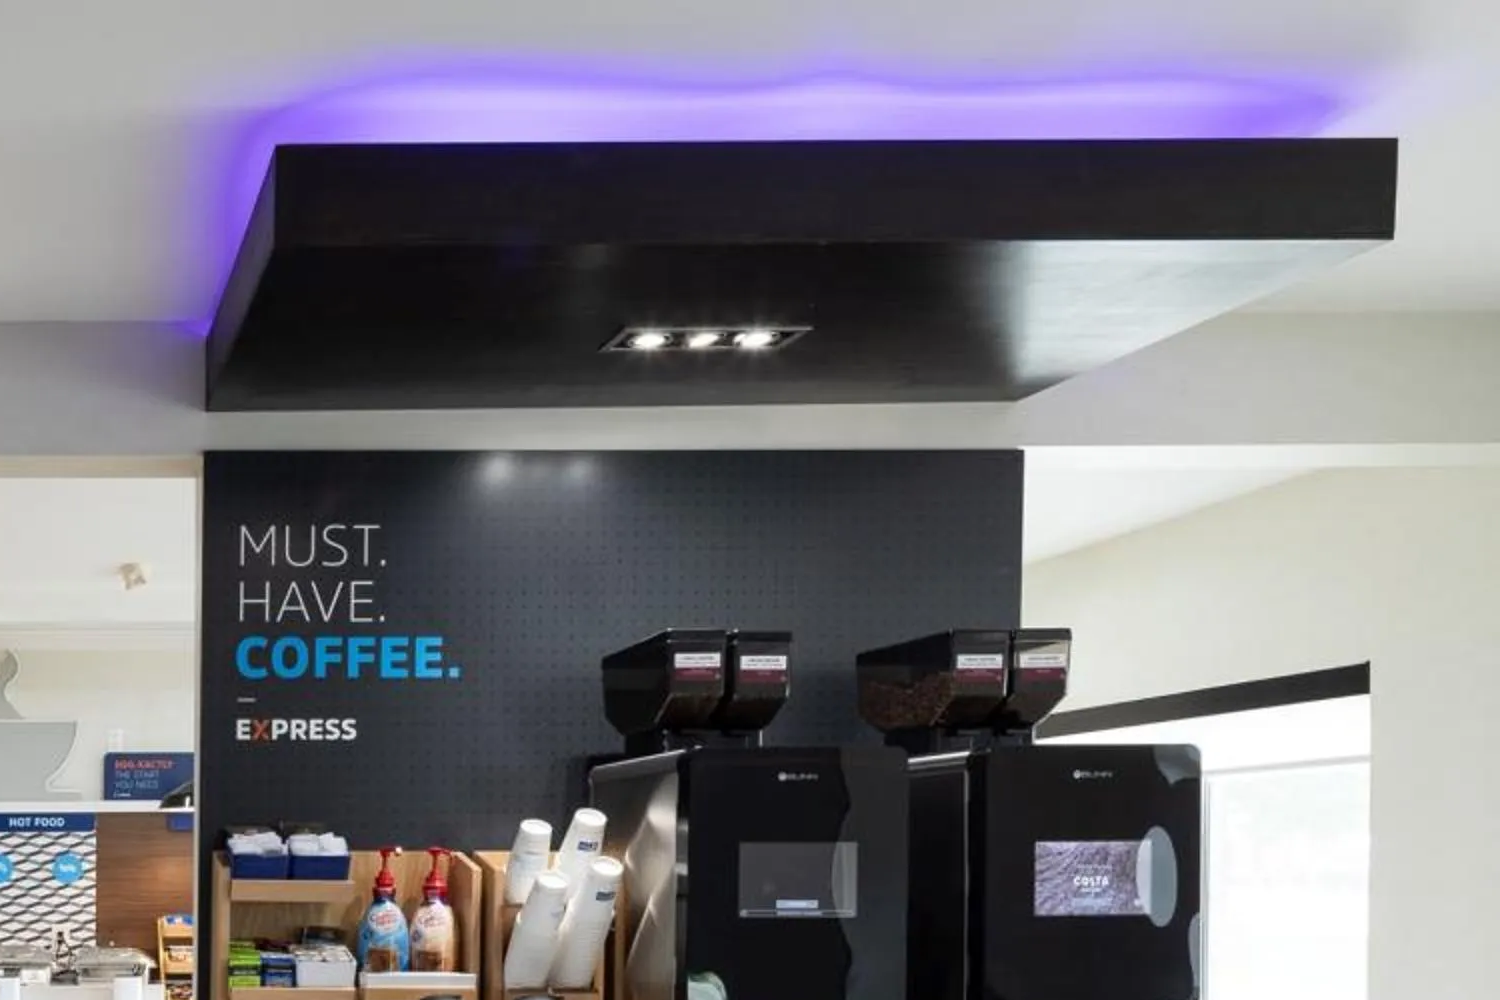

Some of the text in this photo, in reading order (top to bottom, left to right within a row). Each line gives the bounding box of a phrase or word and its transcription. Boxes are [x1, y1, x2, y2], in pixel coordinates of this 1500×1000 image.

[239, 523, 387, 567] MUST.
[238, 580, 386, 623] HAVE.
[235, 635, 461, 679] COFFEE.
[235, 718, 357, 740] EXPRESS
[8, 817, 66, 827] HOT FOOD
[1073, 875, 1110, 887] COSTA
